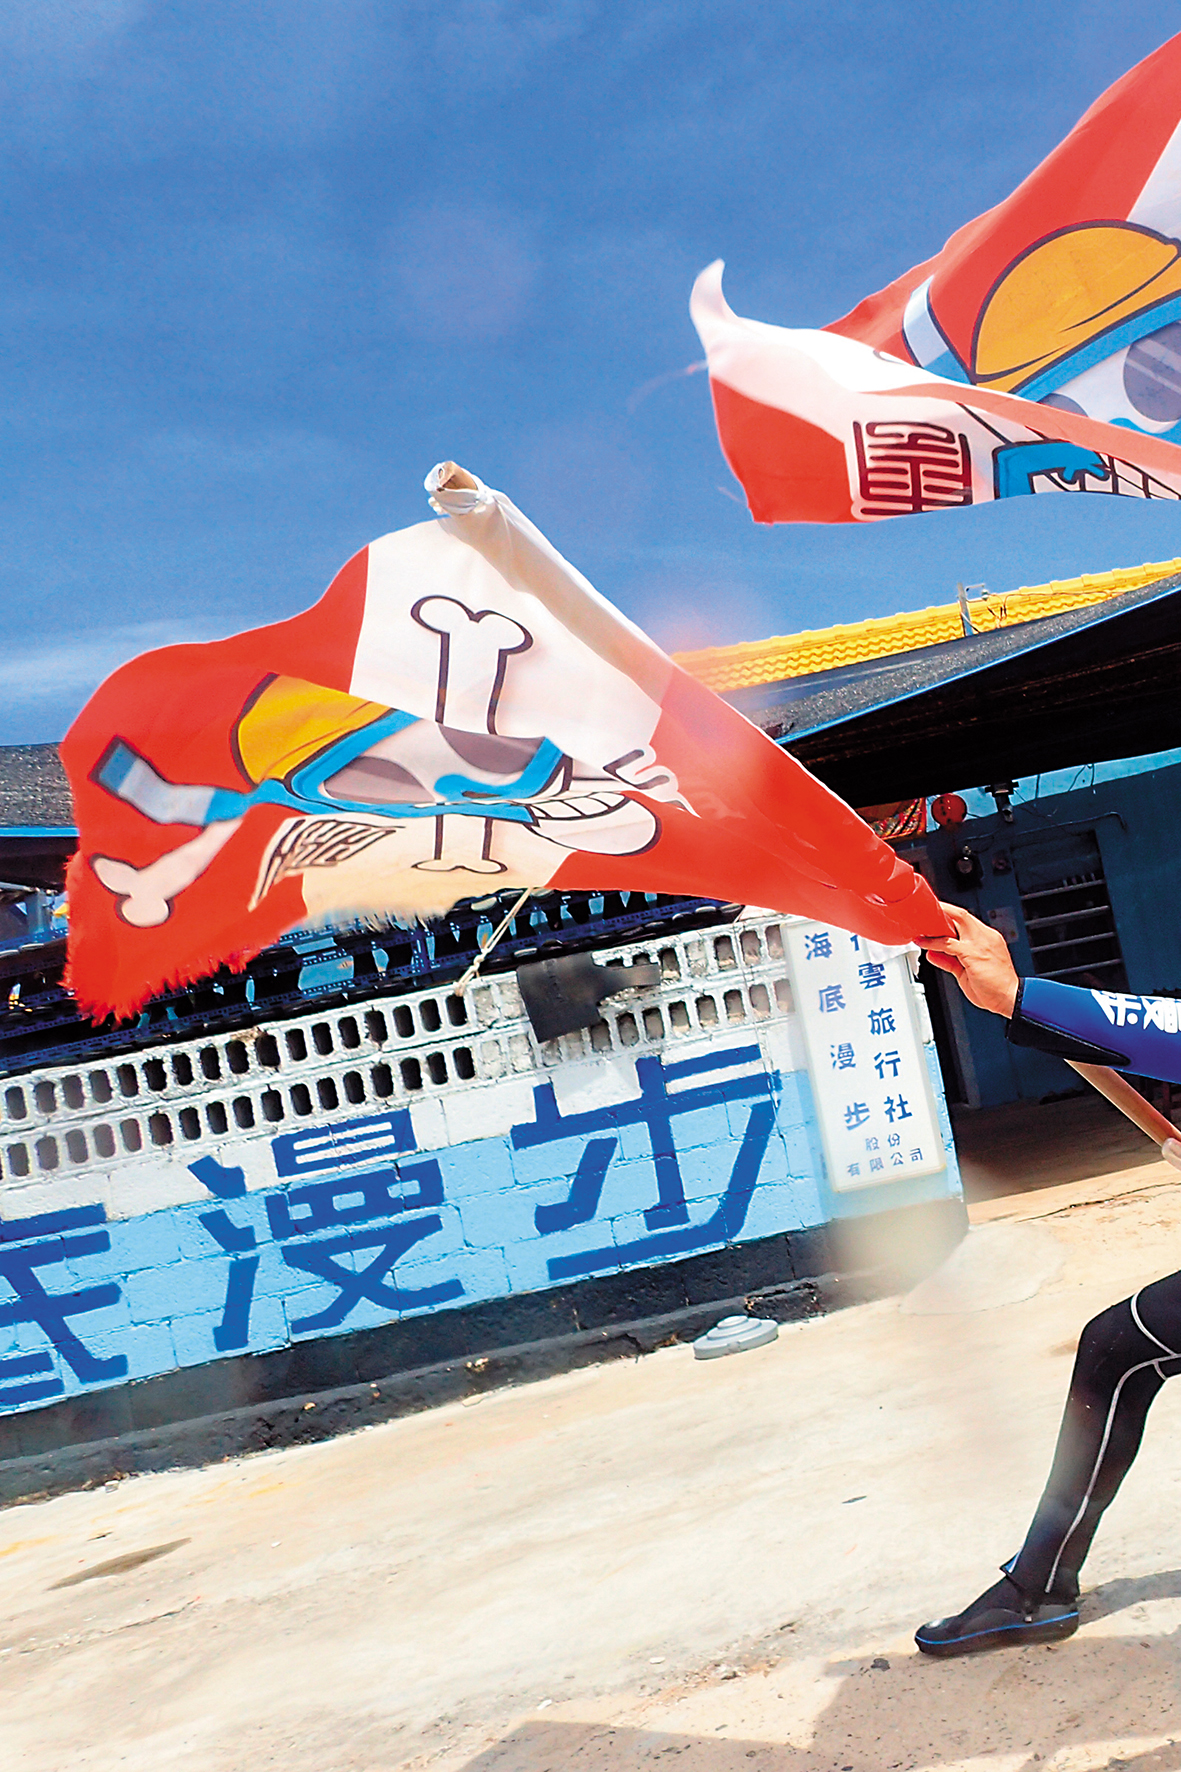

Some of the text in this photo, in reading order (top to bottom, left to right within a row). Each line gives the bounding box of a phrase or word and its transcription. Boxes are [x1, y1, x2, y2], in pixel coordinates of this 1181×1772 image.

[804, 932, 870, 1130] 海底漫步
[850, 935, 912, 1123] 雲旅行社
[847, 1148, 924, 1176] 有限公司
[865, 1132, 901, 1151] 股份
